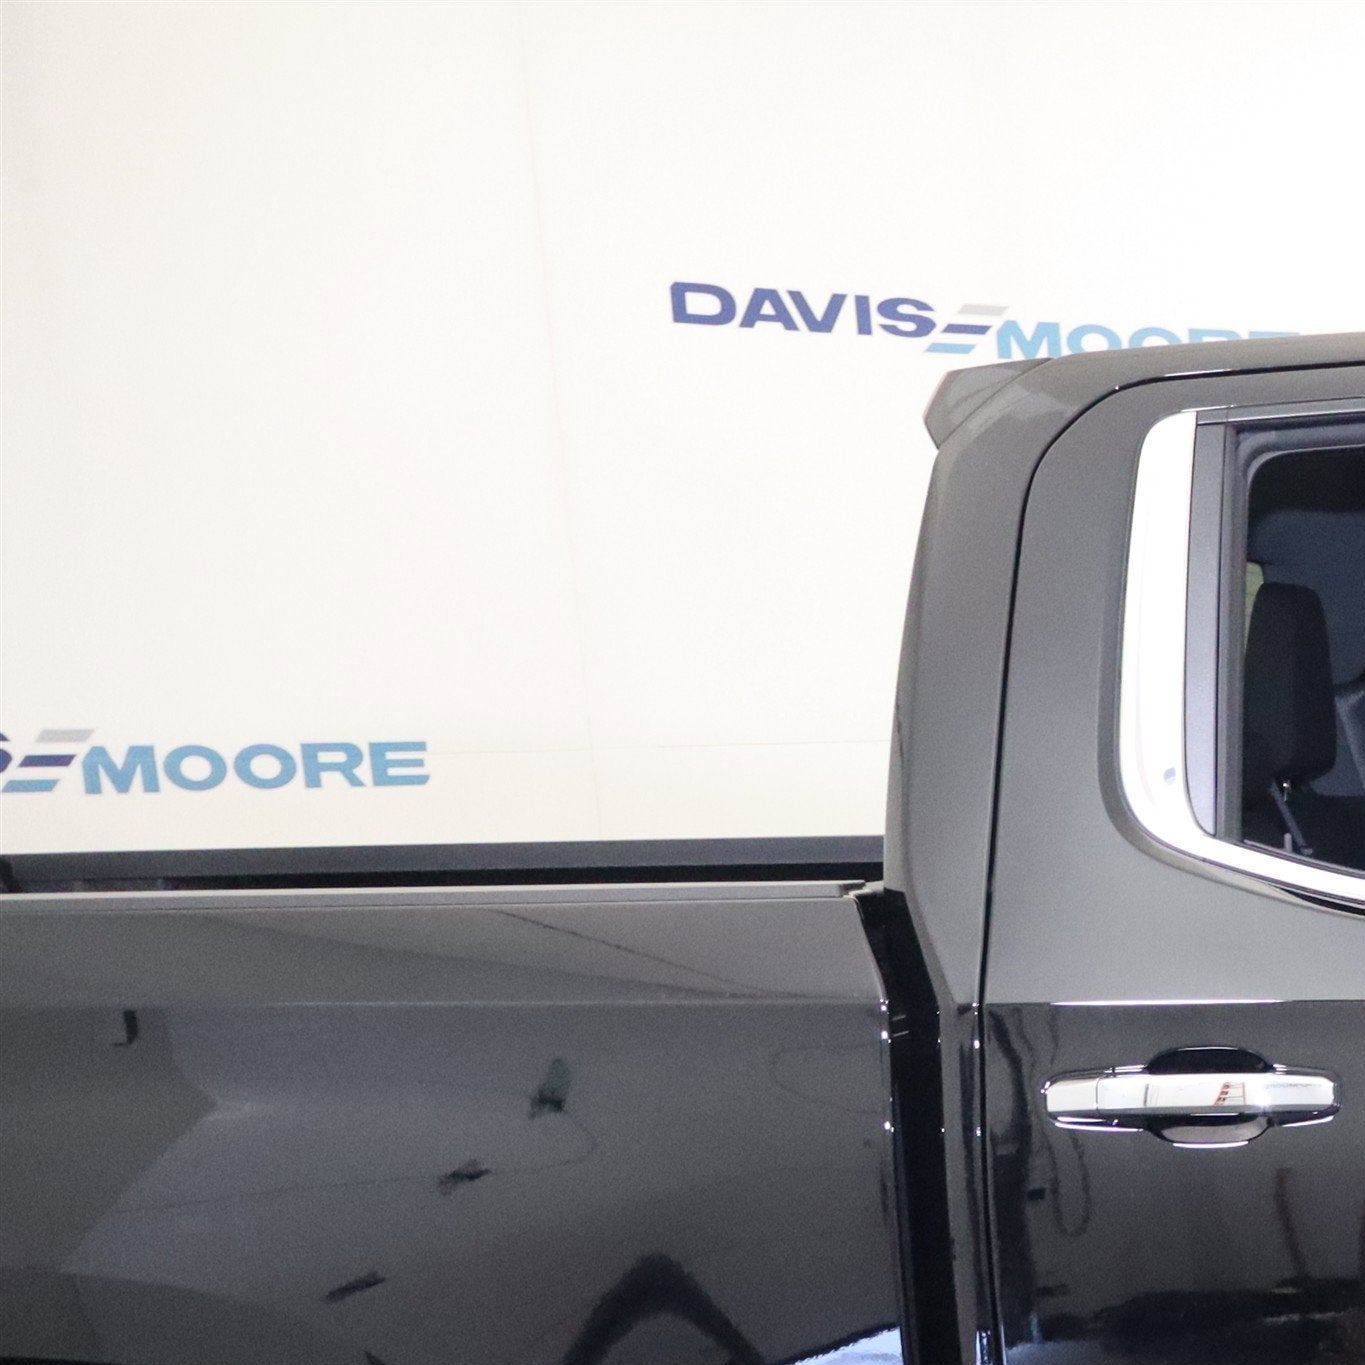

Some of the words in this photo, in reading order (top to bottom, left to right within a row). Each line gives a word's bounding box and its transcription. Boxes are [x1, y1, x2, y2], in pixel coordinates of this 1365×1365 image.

[670, 281, 937, 338] DAVIS
[997, 320, 1300, 360] MOO
[81, 741, 431, 795] MOORE
